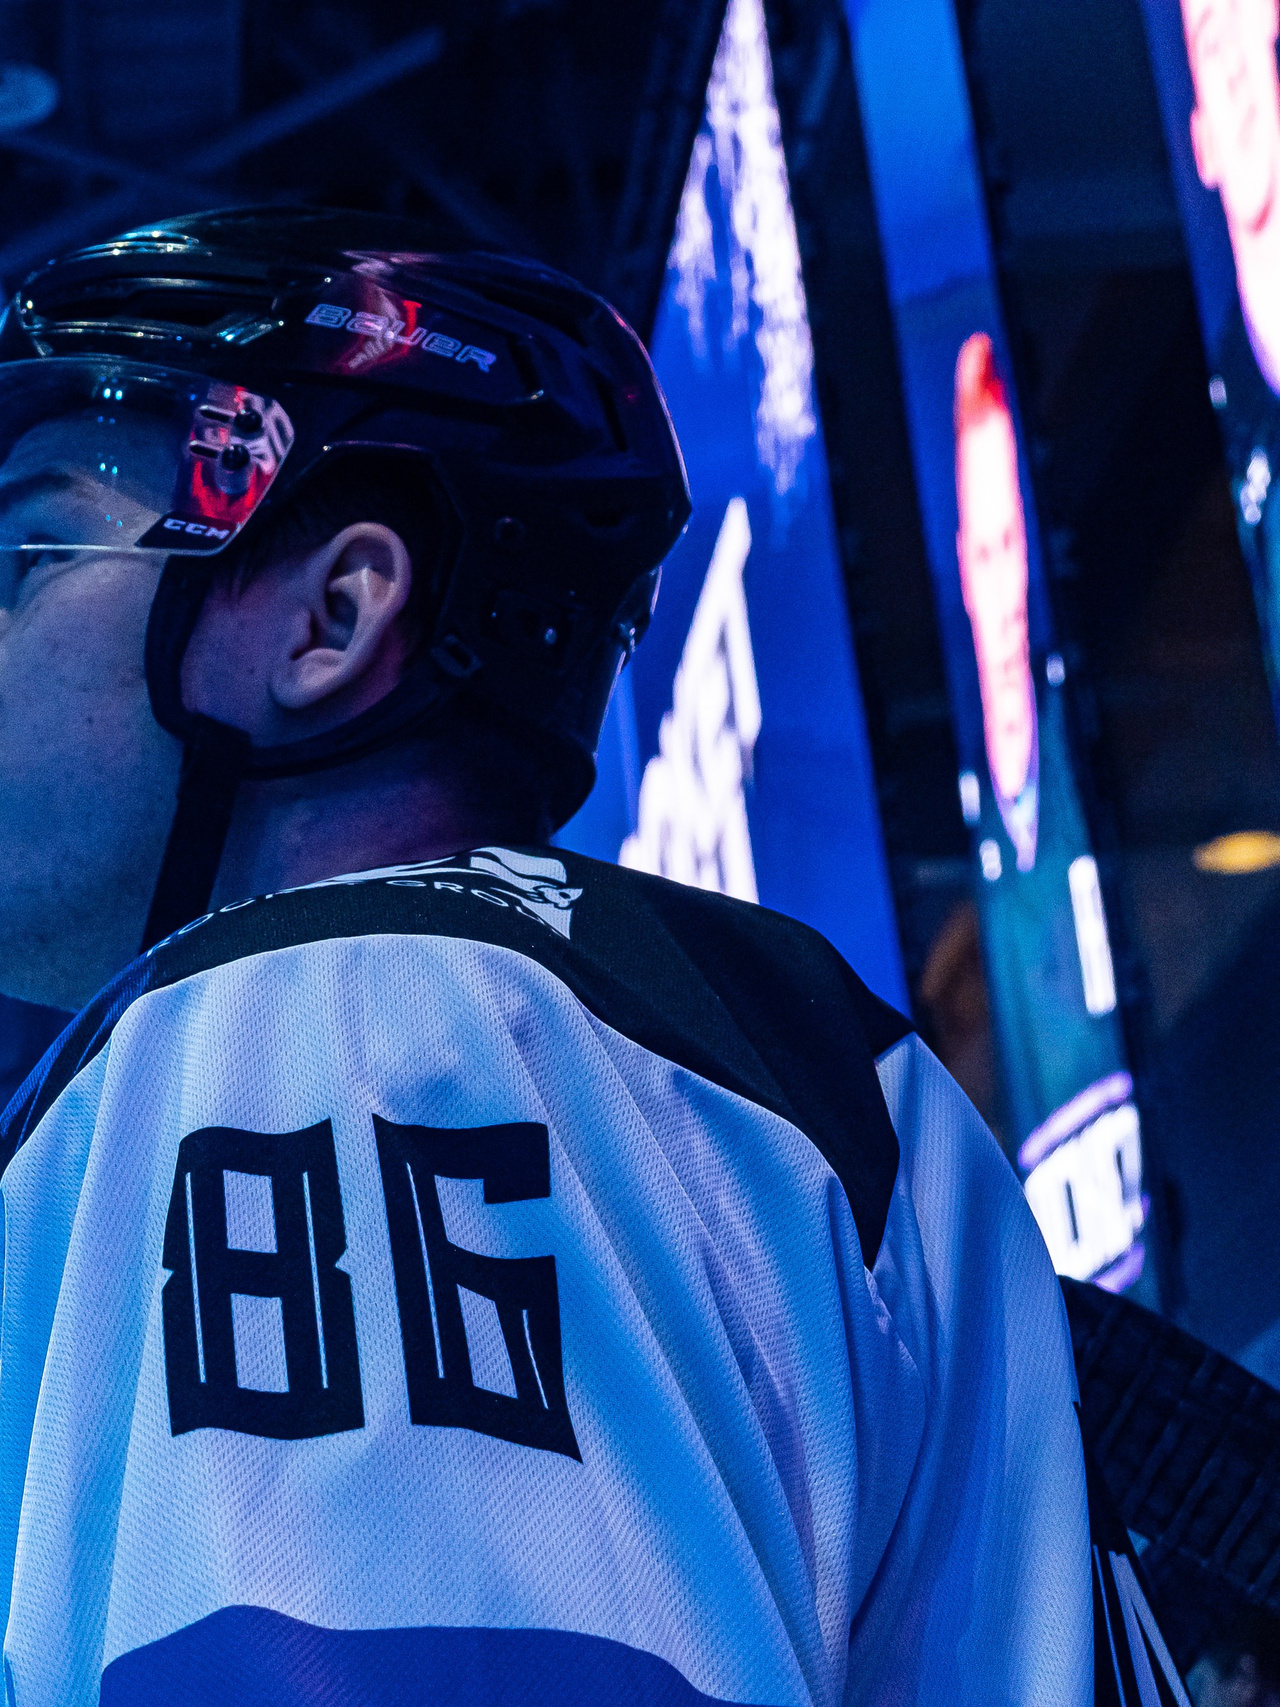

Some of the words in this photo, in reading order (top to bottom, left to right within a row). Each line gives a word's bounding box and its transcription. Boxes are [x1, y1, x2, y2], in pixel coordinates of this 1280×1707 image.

[304, 303, 498, 374] BAUER
[162, 517, 231, 541] CCM
[162, 1113, 582, 1464] 86
